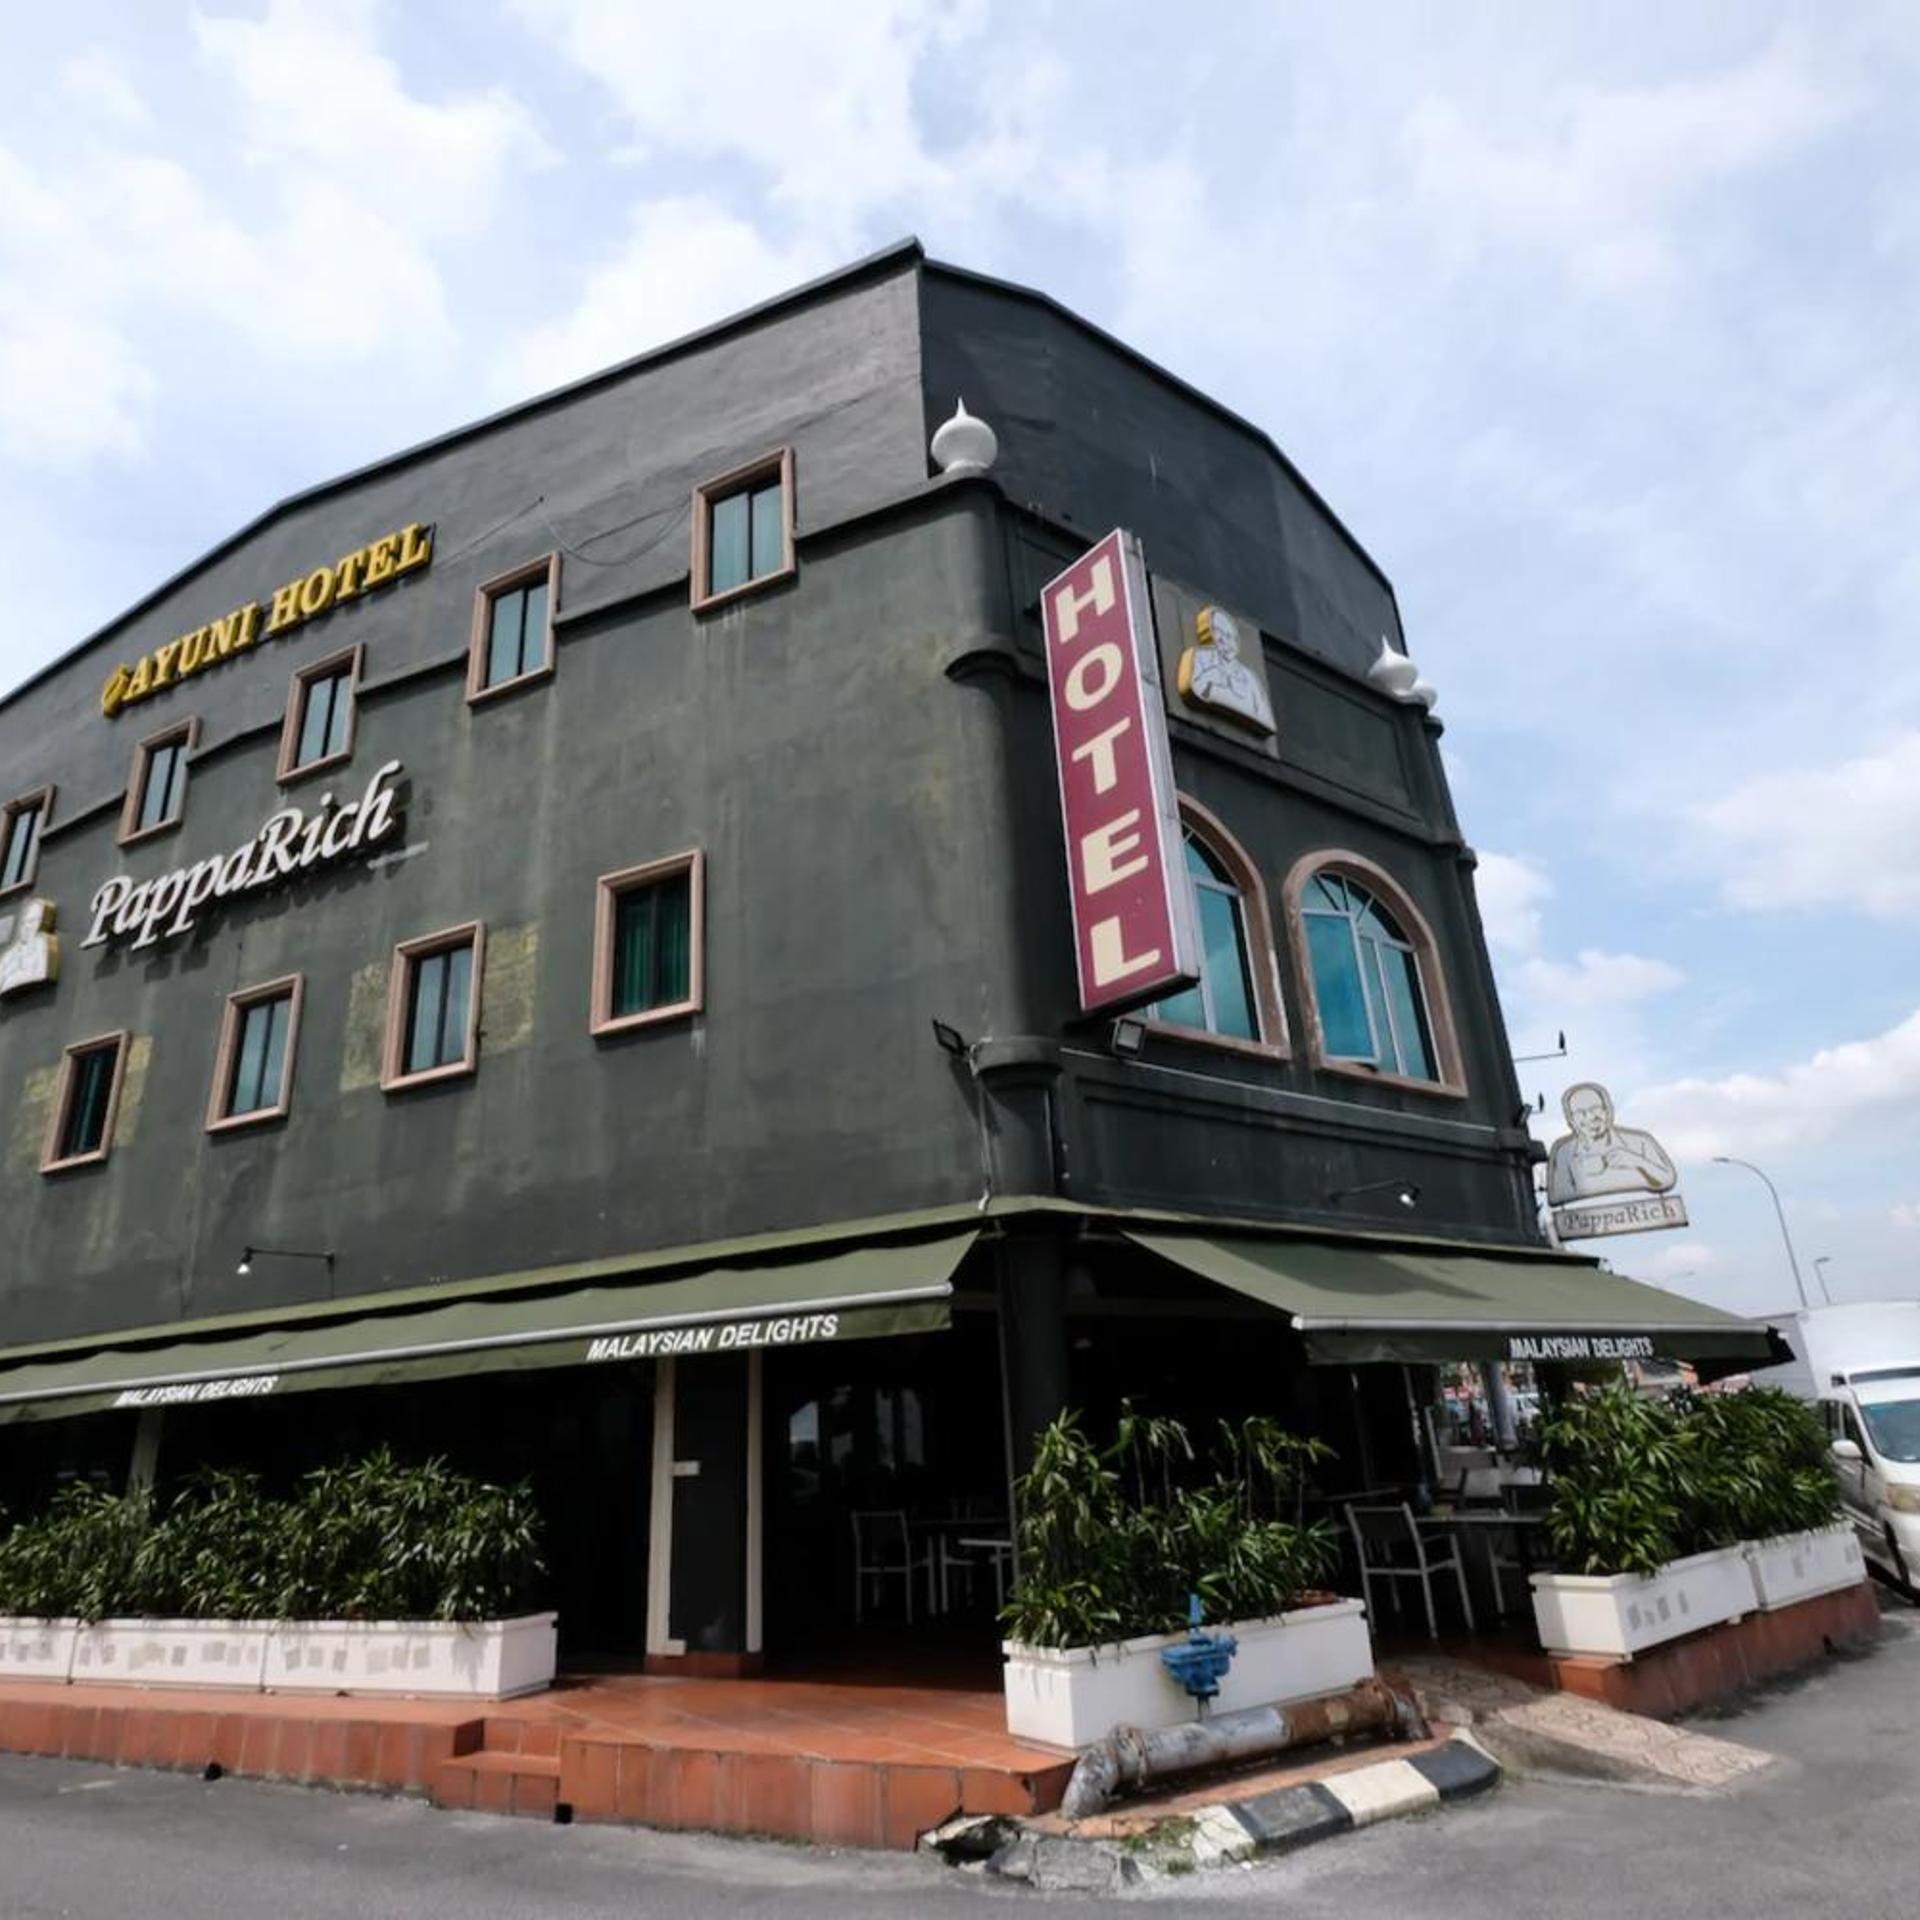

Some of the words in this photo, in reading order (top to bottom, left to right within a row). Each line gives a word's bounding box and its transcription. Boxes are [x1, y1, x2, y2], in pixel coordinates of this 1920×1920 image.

[122, 600, 261, 701] AYUNI
[265, 522, 434, 635] HOTEL
[1055, 554, 1161, 988] HOTEL
[79, 759, 402, 951] PappaRich
[1565, 1201, 1676, 1232] PappaRich
[587, 1328, 713, 1361] MALAYSIAN
[718, 1314, 839, 1348] DELIGHTS
[1509, 1336, 1591, 1359] MALAYSIAN
[1591, 1336, 1654, 1358] DELIGHTS
[113, 1384, 198, 1407] MALAYSIAN
[199, 1375, 279, 1400] DELIGHTS
